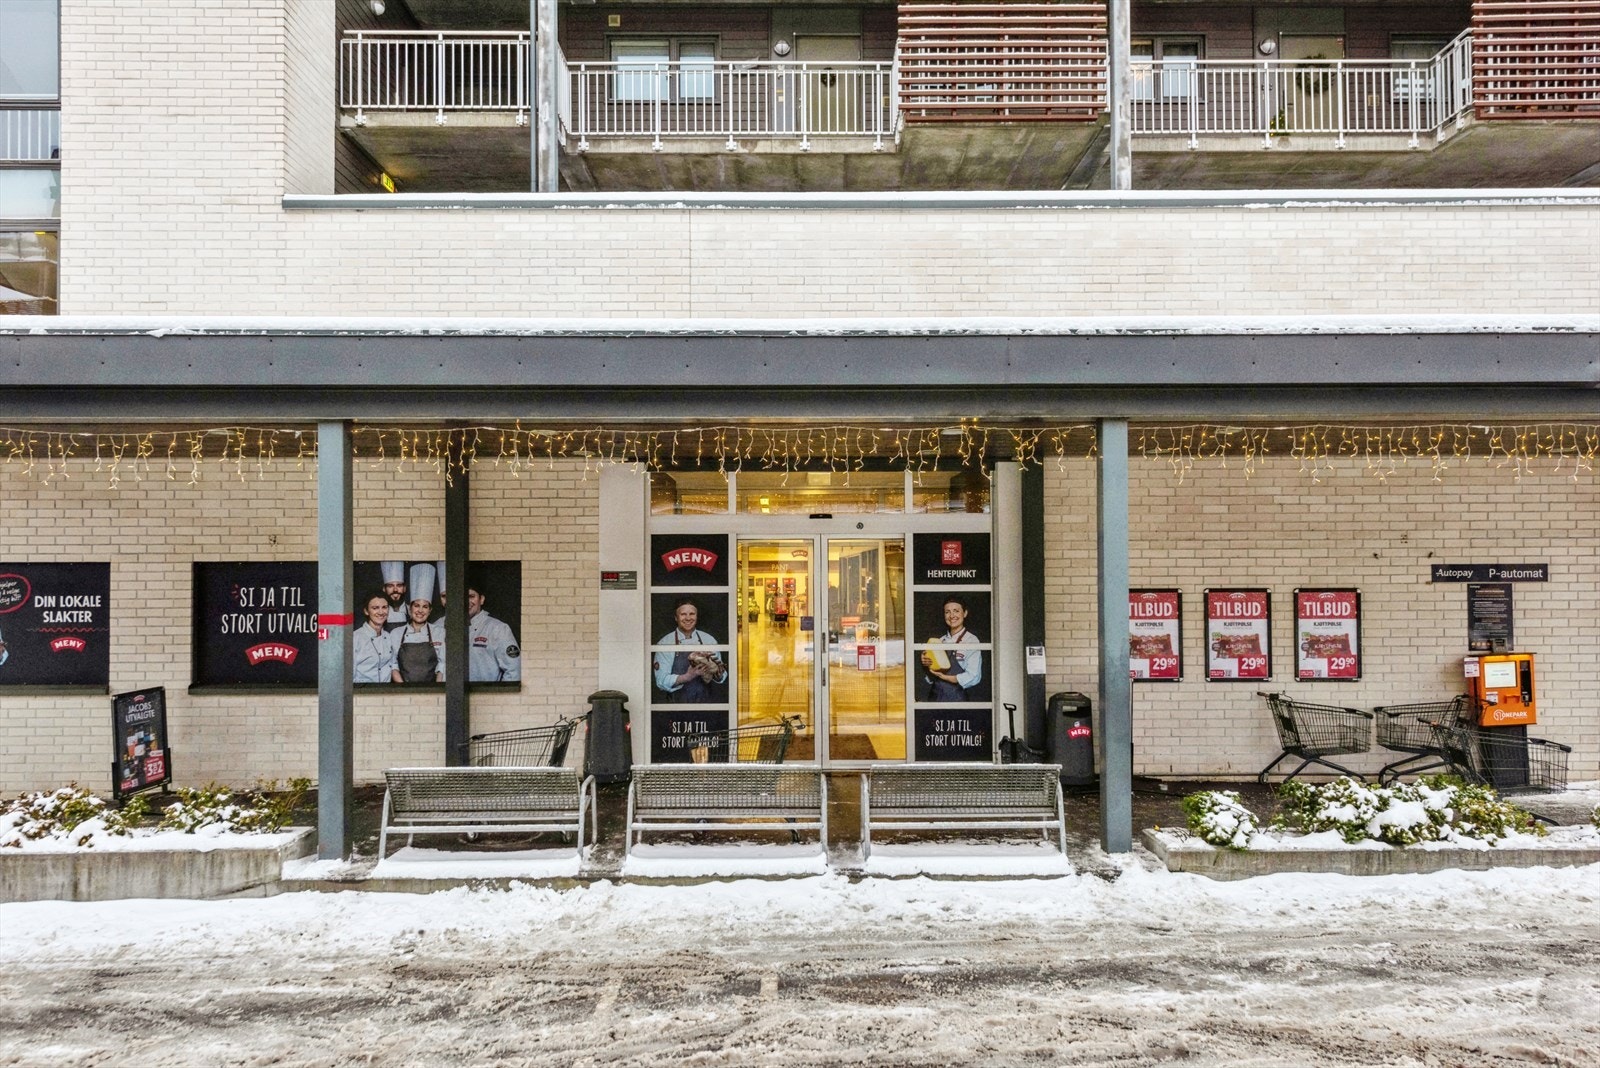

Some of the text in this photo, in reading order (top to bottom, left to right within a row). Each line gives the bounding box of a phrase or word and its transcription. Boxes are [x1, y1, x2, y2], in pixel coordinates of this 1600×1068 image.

[668, 552, 712, 566] MENY
[927, 569, 977, 578] HENTEPUNKT
[1436, 568, 1543, 579] Autopay P-automat
[34, 595, 56, 608] DIN
[60, 595, 102, 608] LOKALE
[240, 586, 306, 608] SI JA TIL
[1129, 602, 1173, 617] TILBUD
[1213, 601, 1262, 617] TILBUD
[1303, 601, 1351, 617] TILBUD
[43, 610, 93, 623] SLAKTER
[221, 613, 263, 634] STORT
[54, 639, 84, 650] MENY
[251, 646, 293, 660] MENY
[128, 701, 152, 714] JACOBS
[125, 709, 156, 723] UTVALGTE
[672, 721, 709, 733] SI JA TIL
[935, 719, 972, 732] SI JA TIL
[662, 735, 686, 748] STORT
[925, 734, 982, 748] STORT UTVALG!
